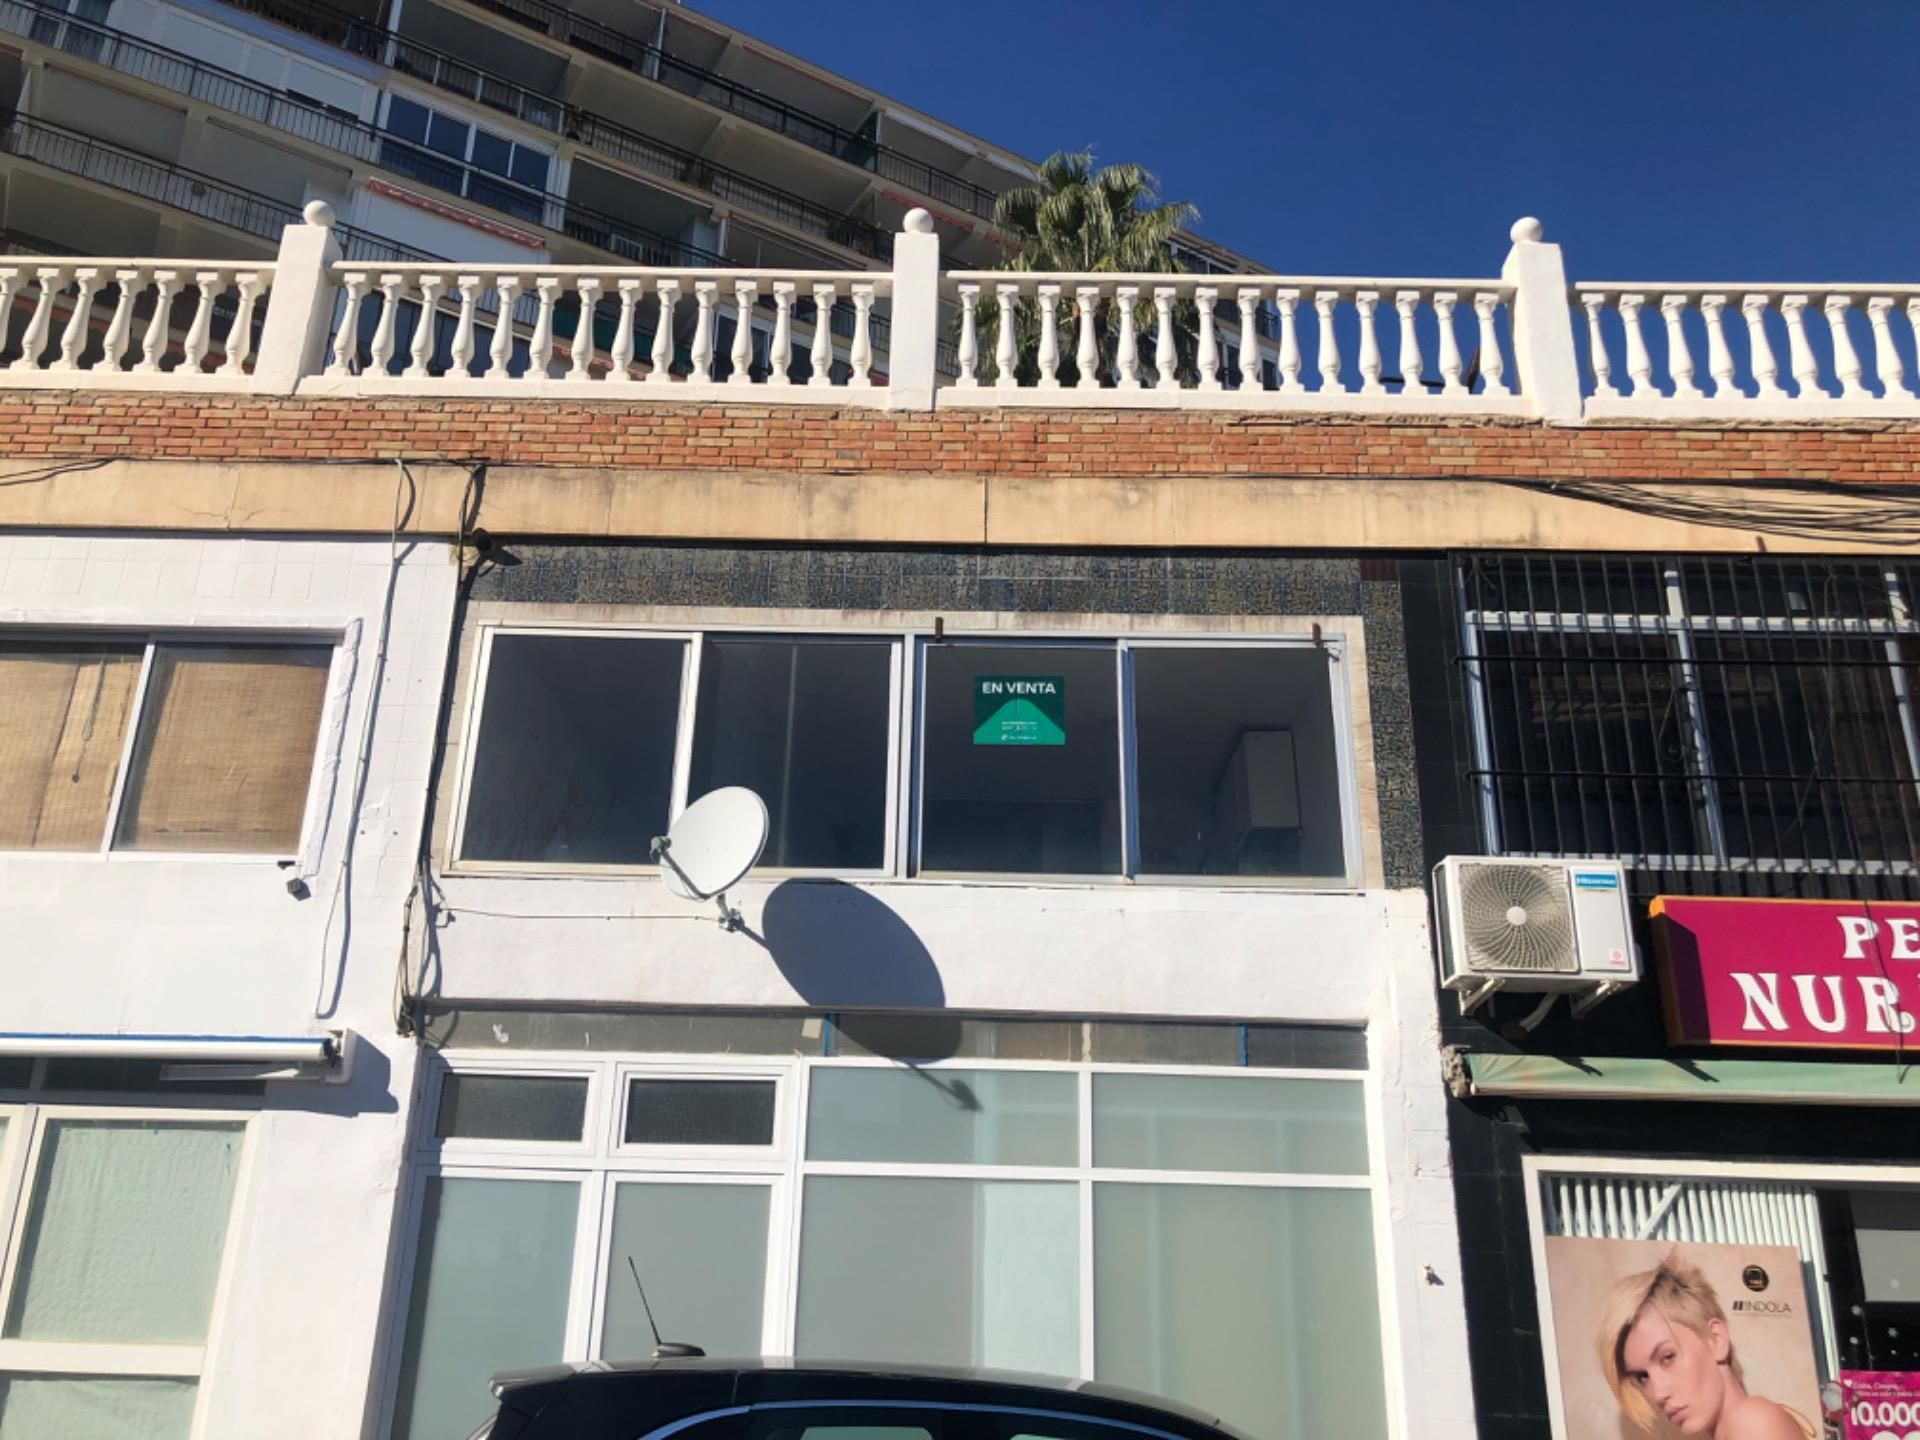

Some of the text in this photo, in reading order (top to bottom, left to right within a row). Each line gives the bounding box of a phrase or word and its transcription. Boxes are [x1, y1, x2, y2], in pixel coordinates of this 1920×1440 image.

[982, 682, 1056, 694] EN VENTA
[1729, 972, 1920, 1034] NUR
